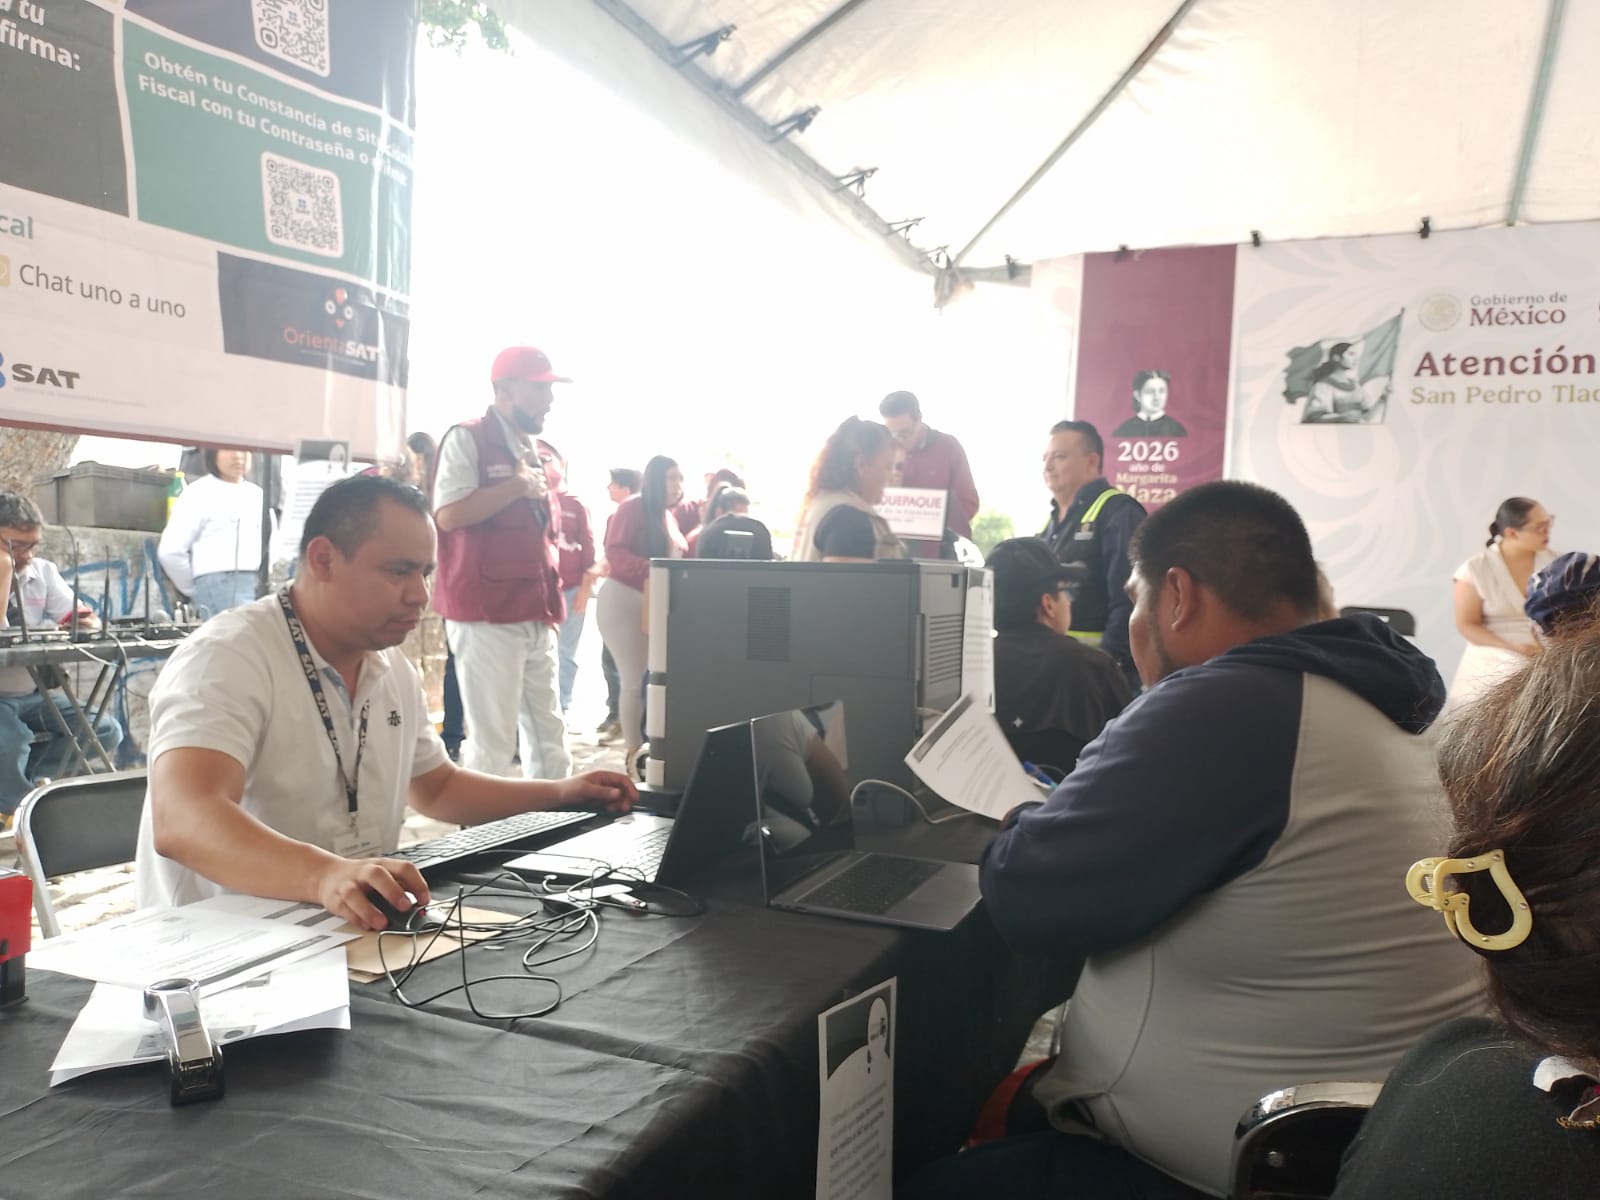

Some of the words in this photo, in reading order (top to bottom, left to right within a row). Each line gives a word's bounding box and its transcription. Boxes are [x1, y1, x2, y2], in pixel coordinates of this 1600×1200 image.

[19, 0, 45, 26] tu
[0, 19, 81, 72] firma:
[144, 51, 208, 87] Obtén
[212, 74, 234, 96] tu
[237, 84, 327, 131] Constancia
[331, 120, 353, 138] de
[138, 73, 196, 107] Fiscal
[201, 97, 233, 121] con
[237, 109, 256, 129] tu
[259, 117, 355, 161] Contraseña
[19, 264, 74, 296] Chat
[80, 281, 123, 305] uno
[129, 293, 140, 309] a
[147, 297, 186, 319] uno
[1469, 293, 1545, 307] Gobierno
[1549, 291, 1568, 304] de
[1469, 305, 1567, 327] México
[283, 326, 380, 362] OrientaSAT
[1413, 345, 1596, 377] Atención
[11, 362, 81, 390] SAT
[1410, 386, 1456, 405] San
[1466, 384, 1542, 404] Pedro
[1117, 440, 1180, 462] 2026
[1115, 472, 1178, 486] Margarita
[287, 617, 305, 645] SAT
[300, 652, 319, 682] SAT
